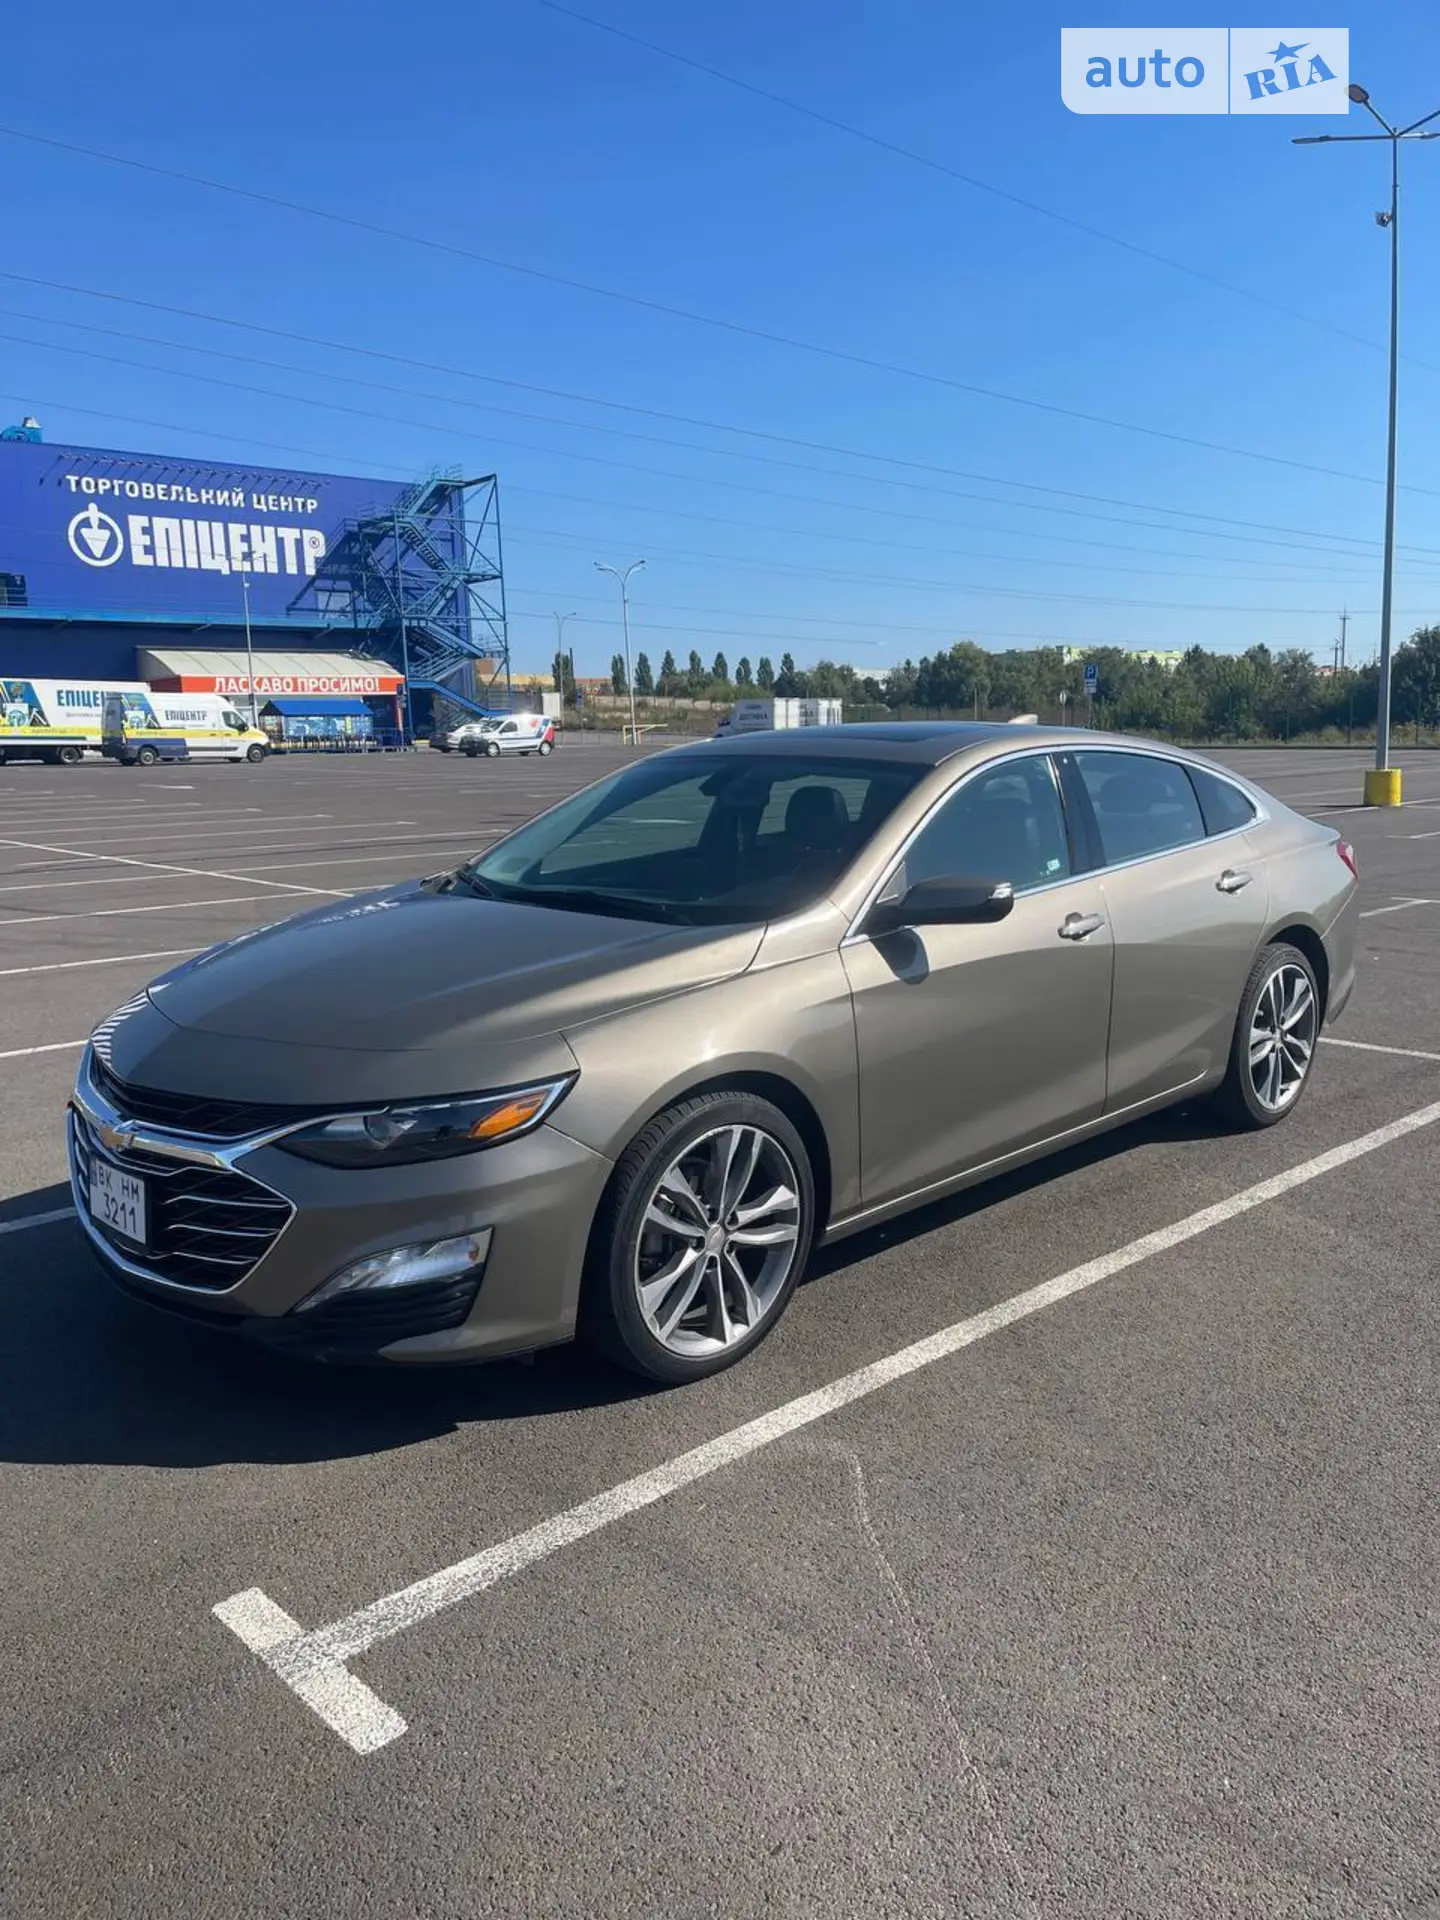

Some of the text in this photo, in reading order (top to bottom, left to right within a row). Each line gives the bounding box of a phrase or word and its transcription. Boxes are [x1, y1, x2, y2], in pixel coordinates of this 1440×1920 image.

[66, 475, 318, 514] ТОРГОВЕЛЬНИЙ ЦЕНТР
[128, 515, 326, 576] ЕПІЦЕНТР
[214, 677, 380, 693] ЛАСКАВО ПРОСИМО!
[165, 710, 207, 721] ЕПІЦЕНТР
[103, 1192, 136, 1234] 3211
